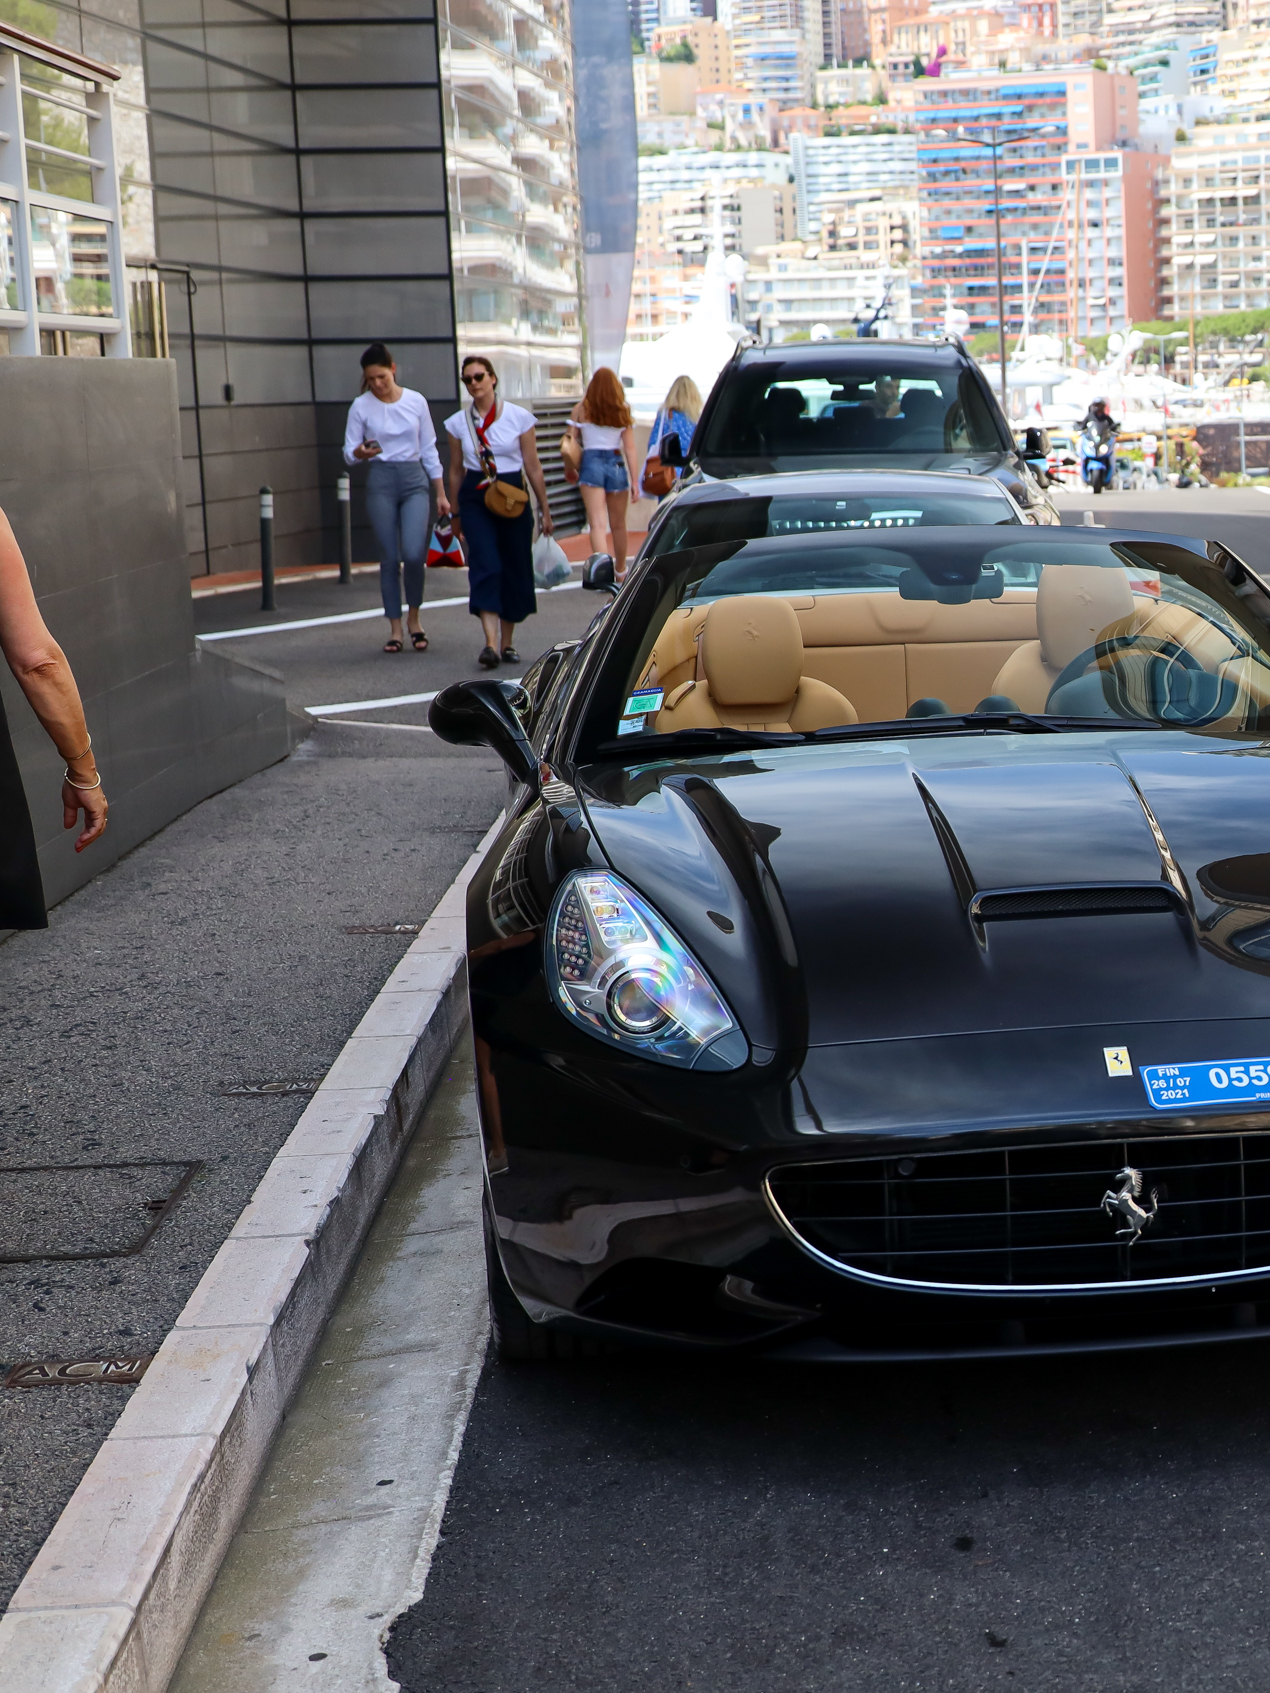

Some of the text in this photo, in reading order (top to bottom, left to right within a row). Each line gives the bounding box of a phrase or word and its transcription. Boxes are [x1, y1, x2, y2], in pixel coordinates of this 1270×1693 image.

[1157, 1067, 1180, 1077] FIN
[225, 1081, 317, 1093] ACM
[1151, 1079, 1167, 1089] 26
[1176, 1077, 1191, 1087] 07
[1160, 1088, 1190, 1100] 2021
[15, 1360, 141, 1379] ACM
